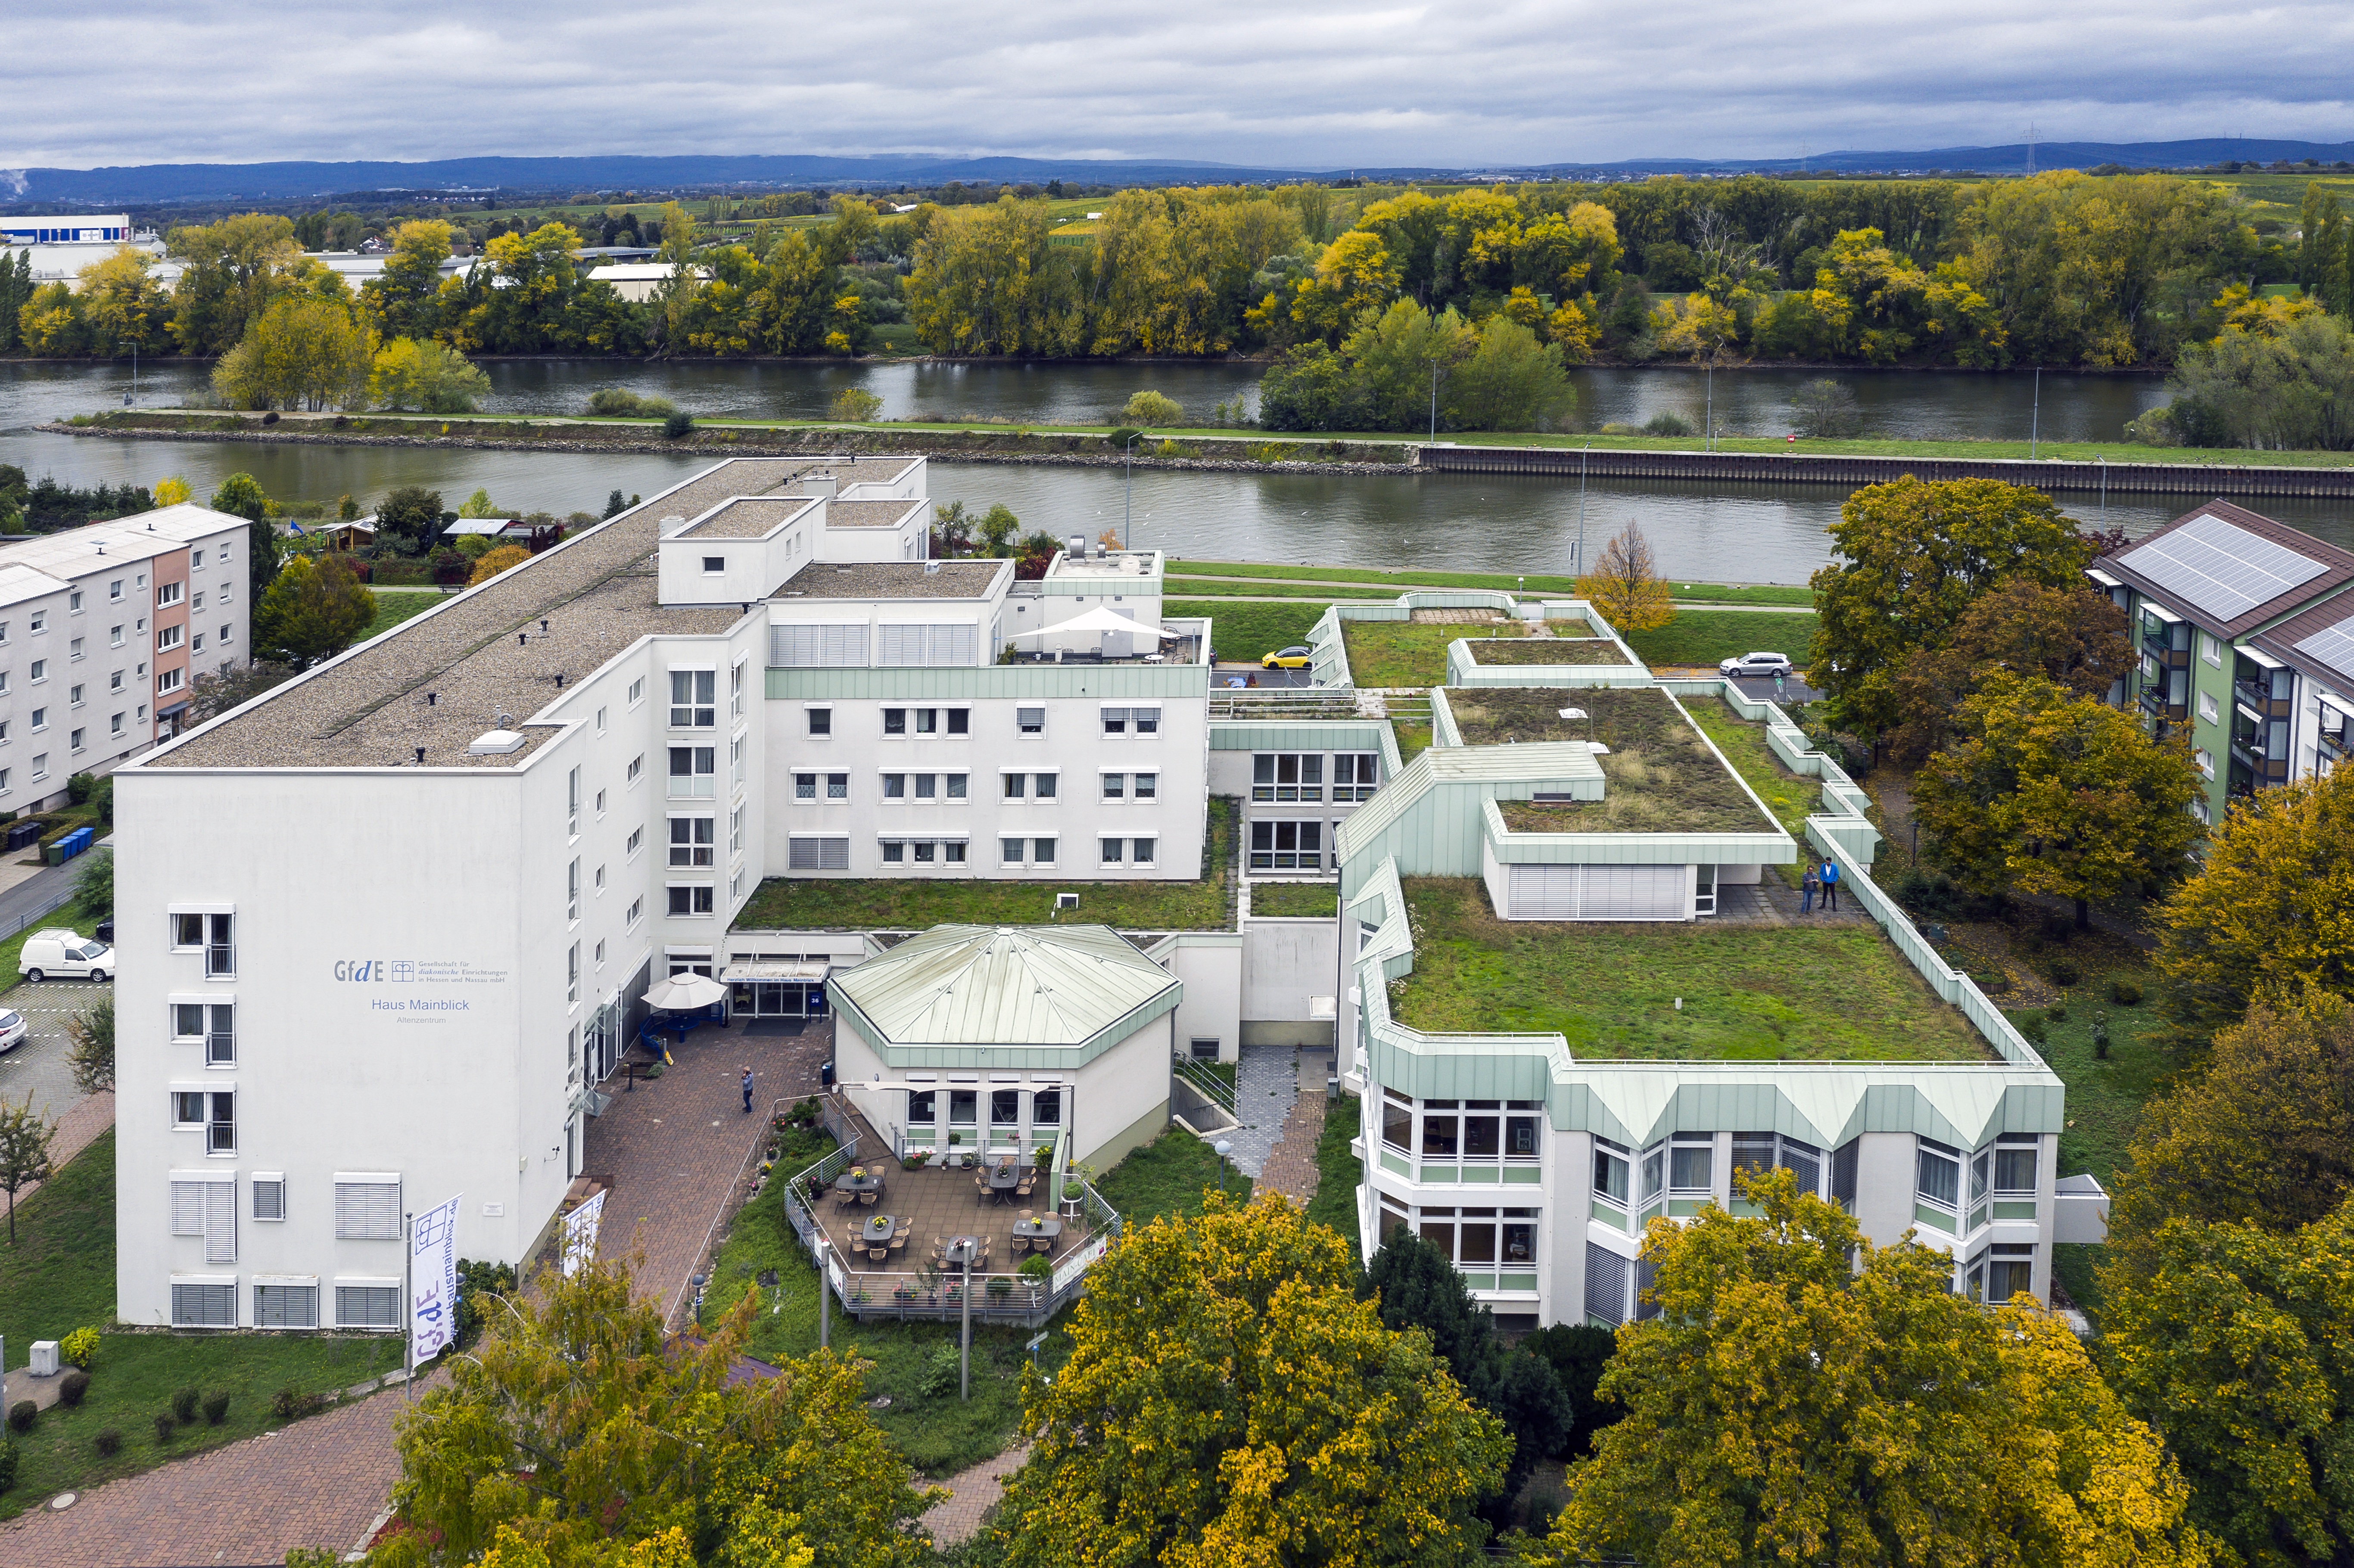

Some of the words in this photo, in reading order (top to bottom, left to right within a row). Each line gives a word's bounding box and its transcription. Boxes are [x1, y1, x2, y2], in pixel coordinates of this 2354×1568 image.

[334, 960, 383, 982] GfdE
[372, 999, 405, 1010] Haus
[409, 999, 470, 1011] Mainblick
